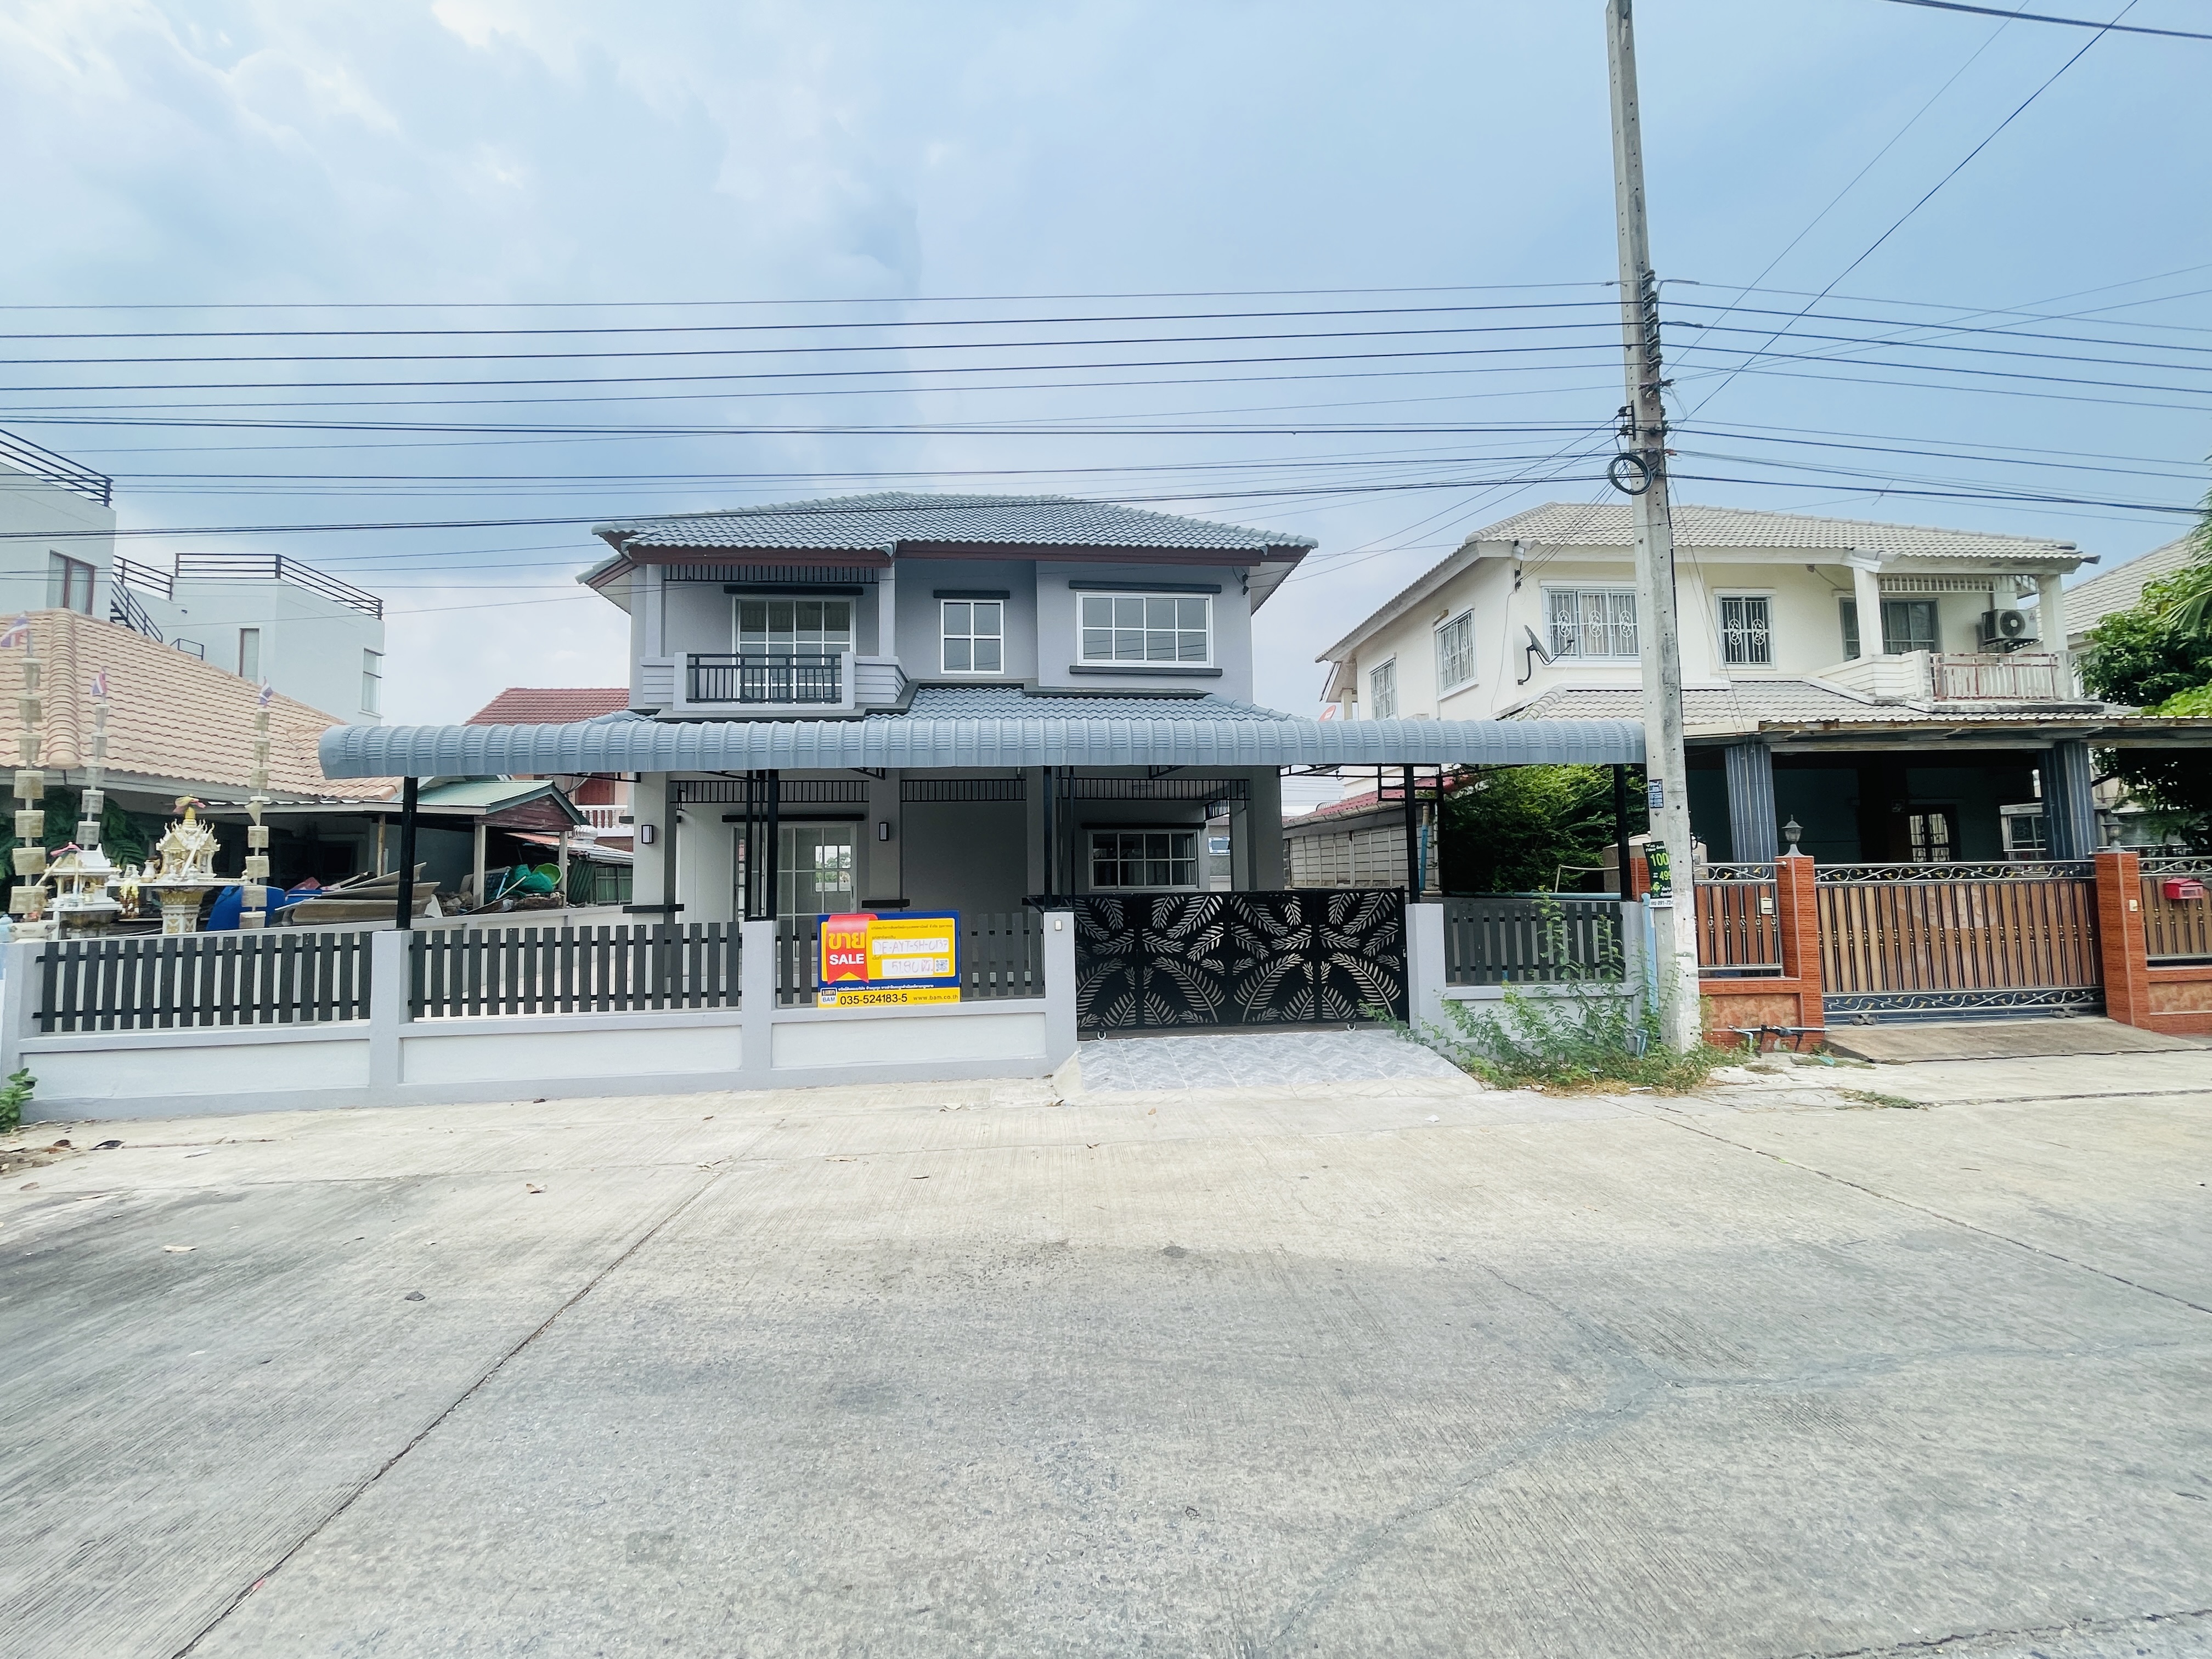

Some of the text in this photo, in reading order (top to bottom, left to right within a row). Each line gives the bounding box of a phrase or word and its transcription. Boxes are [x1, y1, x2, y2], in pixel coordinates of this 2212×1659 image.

[1650, 853, 1670, 866] 100
[828, 932, 865, 950] ขาย
[829, 953, 865, 965] SALE
[840, 994, 907, 1005] 035-524183-5
